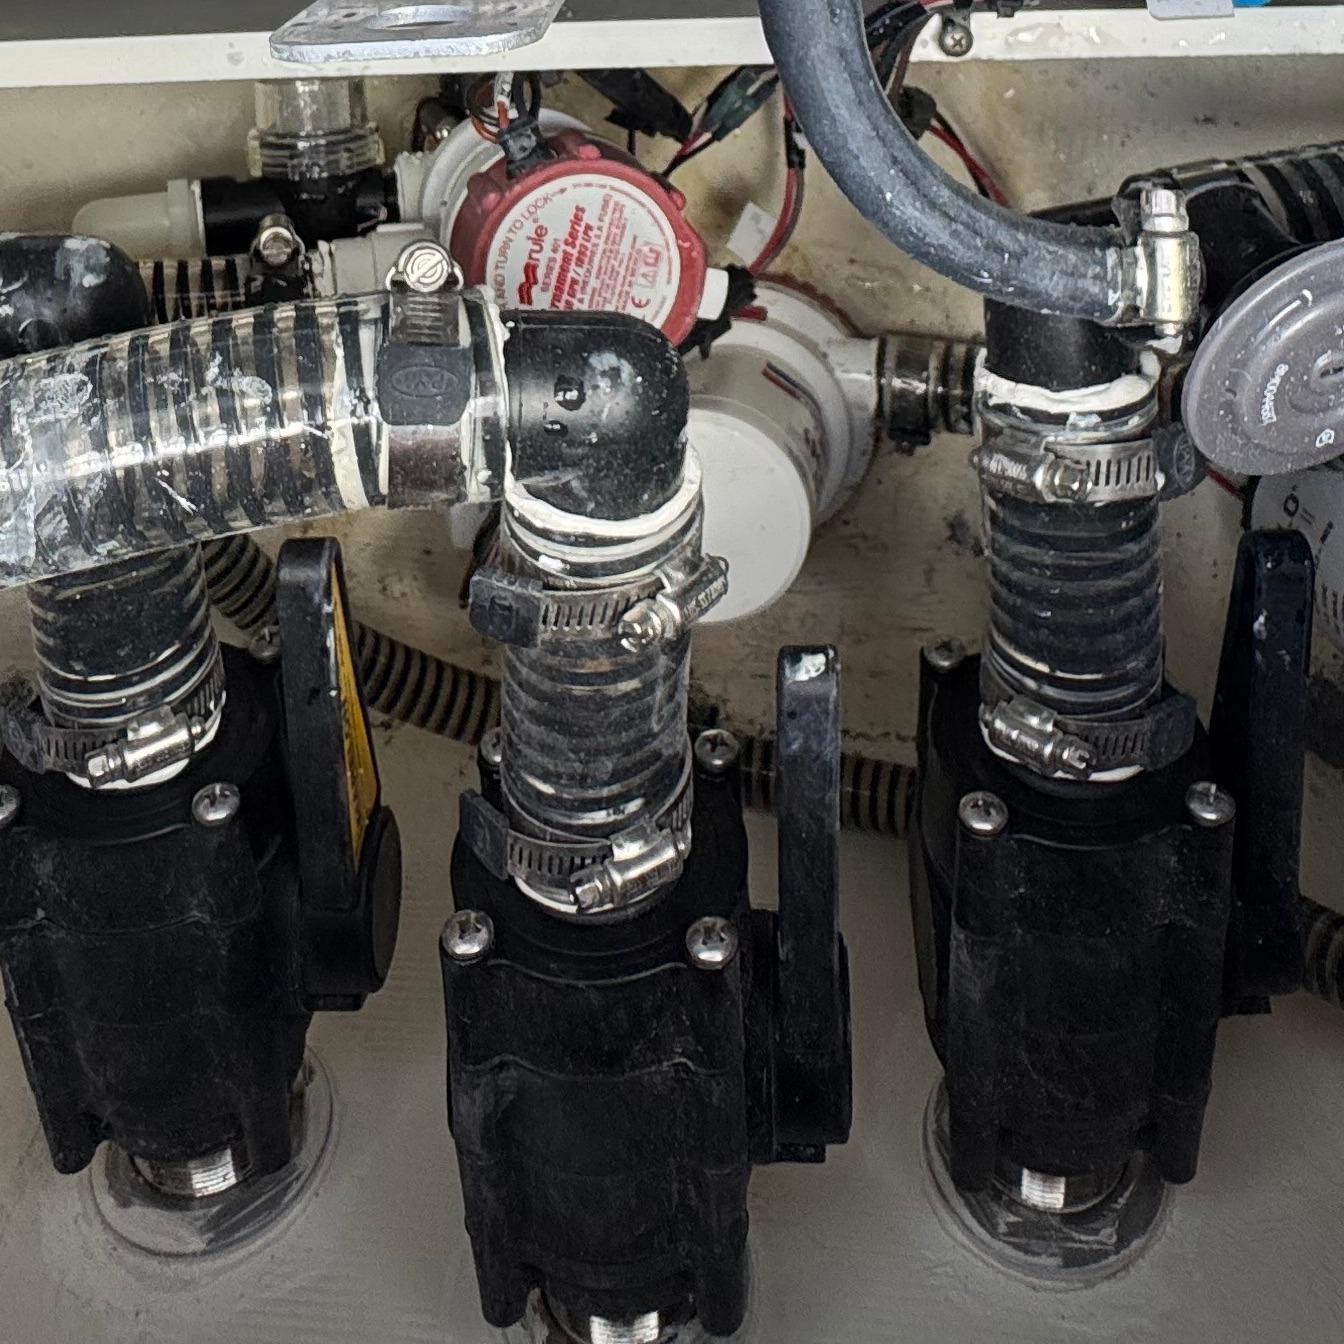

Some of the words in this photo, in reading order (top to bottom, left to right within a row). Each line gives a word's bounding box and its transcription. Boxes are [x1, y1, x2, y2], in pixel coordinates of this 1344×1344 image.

[496, 234, 513, 270] TURN
[507, 218, 523, 235] TO
[521, 194, 553, 220] LOCK
[526, 224, 548, 262] rule
[563, 204, 585, 249] Series
